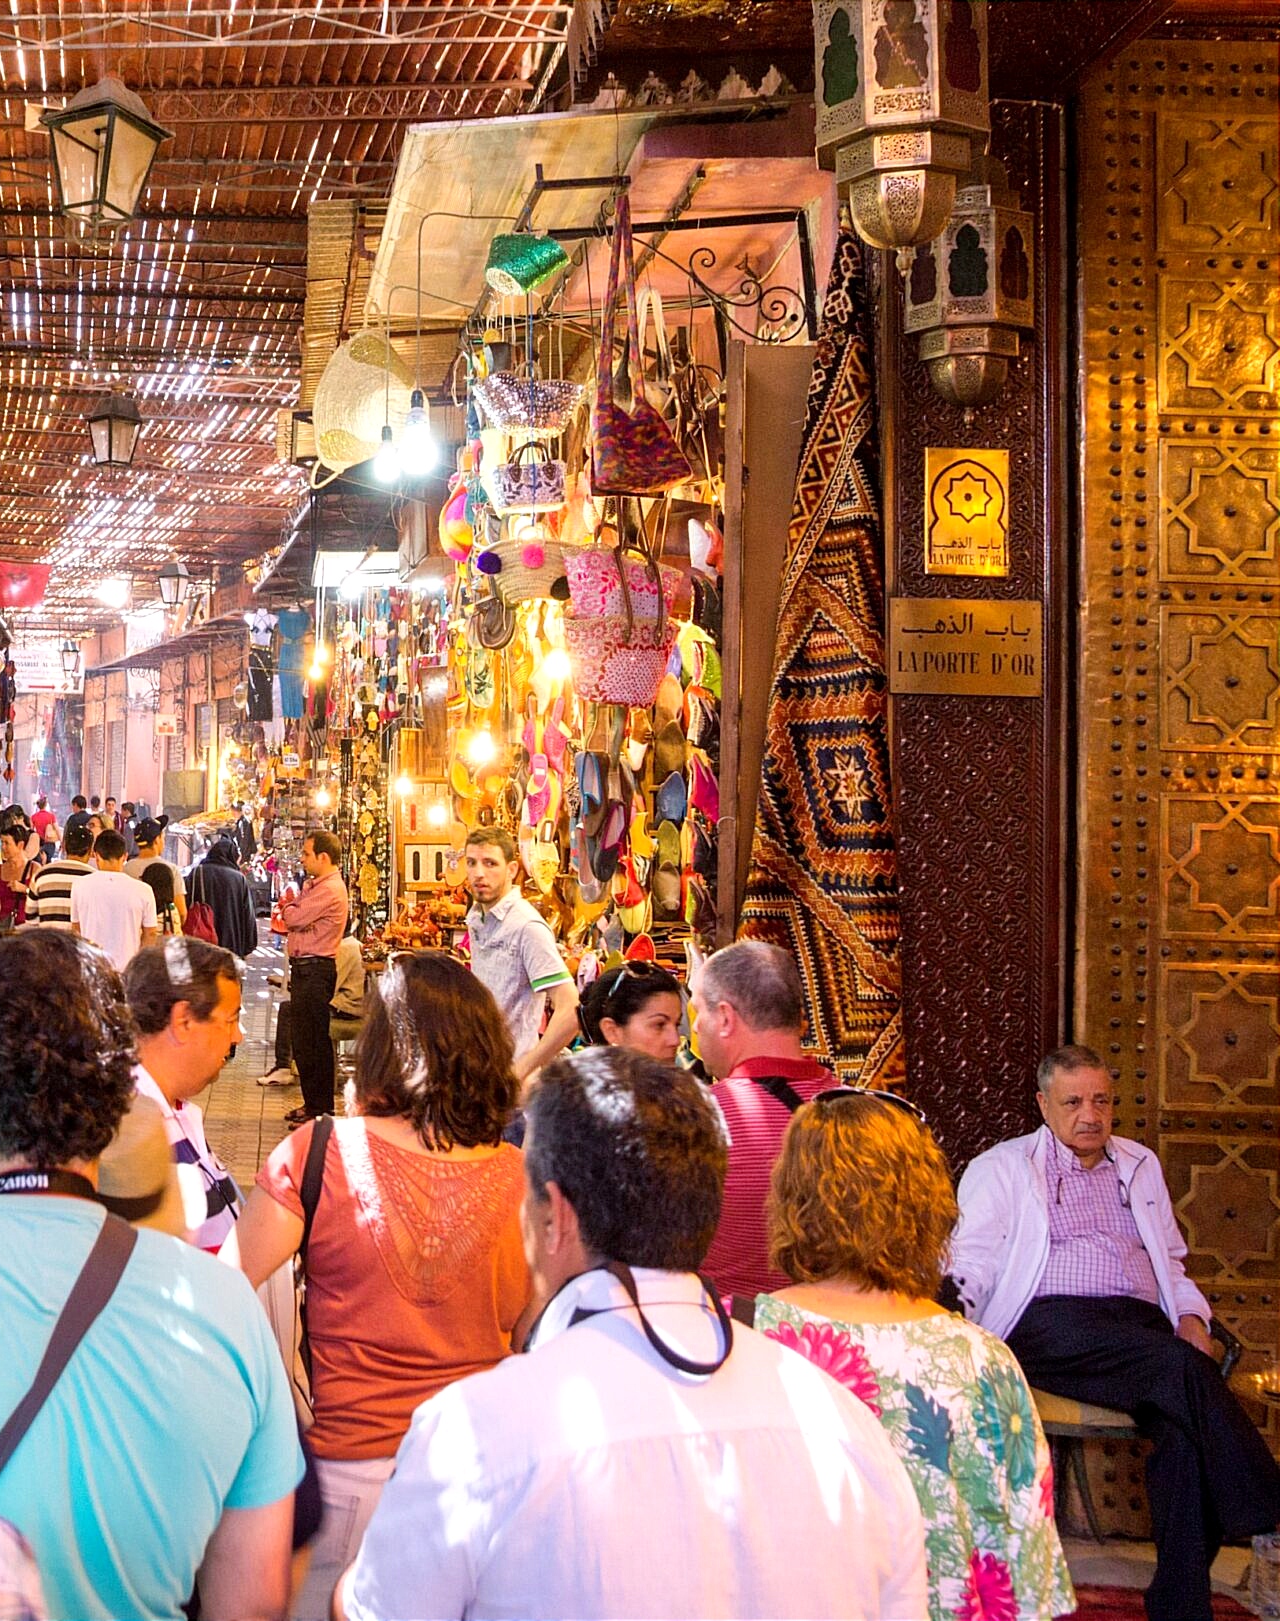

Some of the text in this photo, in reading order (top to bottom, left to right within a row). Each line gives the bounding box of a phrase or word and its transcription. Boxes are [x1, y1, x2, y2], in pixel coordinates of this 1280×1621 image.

[933, 537, 1002, 552] باب الذهب
[933, 553, 944, 565] LA
[946, 553, 975, 566] PORTE
[901, 612, 1031, 642] باب الذهب
[898, 651, 1035, 676] LA PORTE D'OR
